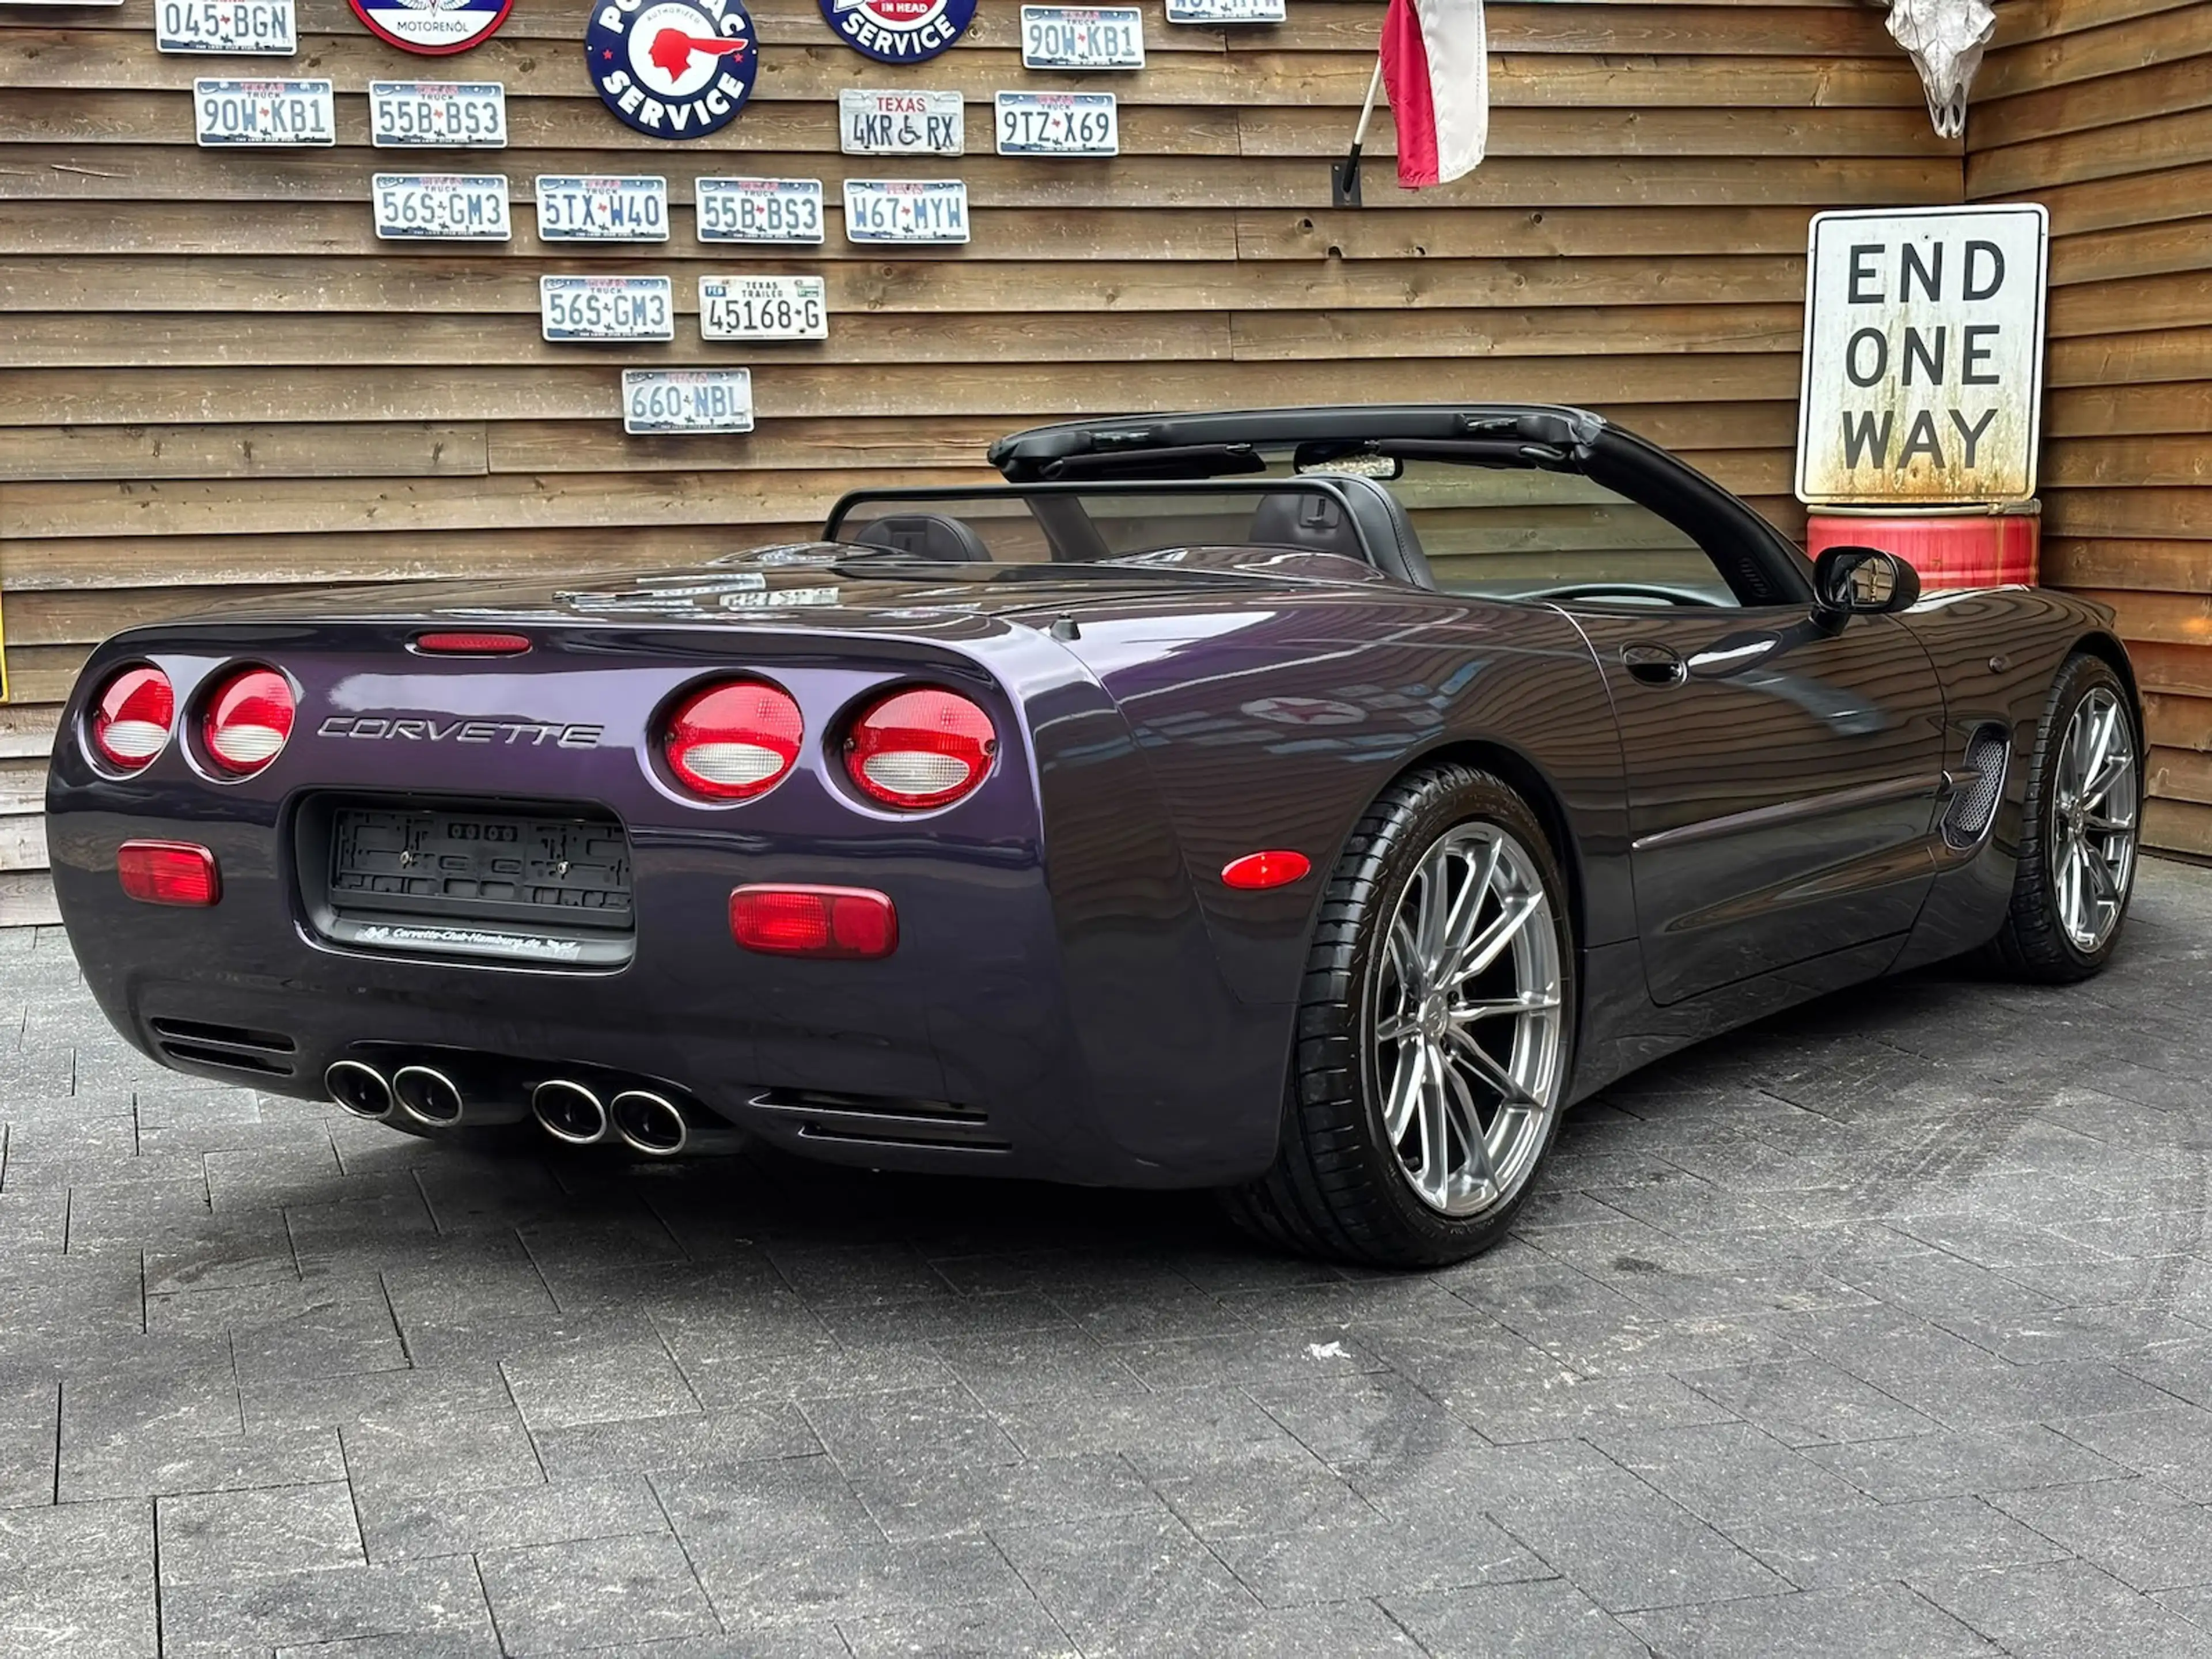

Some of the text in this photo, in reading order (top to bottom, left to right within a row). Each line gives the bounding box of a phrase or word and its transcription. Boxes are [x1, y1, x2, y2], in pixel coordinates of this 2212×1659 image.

[165, 3, 287, 39] 045 BGN
[881, 2, 928, 13] IN HEAD
[841, 12, 956, 56] SERVICE
[1029, 25, 1135, 56] 90W KB1
[203, 99, 326, 132] 90W KB1
[378, 100, 499, 134] 55B BS3
[602, 70, 745, 131] SERVICE
[876, 97, 926, 112] TEXAS
[853, 115, 955, 147] 4KR RX
[1004, 111, 1109, 143] 9TZ X69
[382, 192, 501, 225] 56S GM3
[544, 194, 596, 226] 5TX
[704, 196, 817, 230] 55B BS3
[853, 197, 961, 229] W67 MYW
[1847, 240, 2005, 304] END
[550, 294, 665, 327] 56S GM3
[709, 300, 820, 330] 45168 G
[1845, 324, 2001, 388] ONE
[631, 385, 747, 418] 660 NBL
[1842, 408, 1998, 469] WAY
[316, 716, 605, 749] CORVETTE
